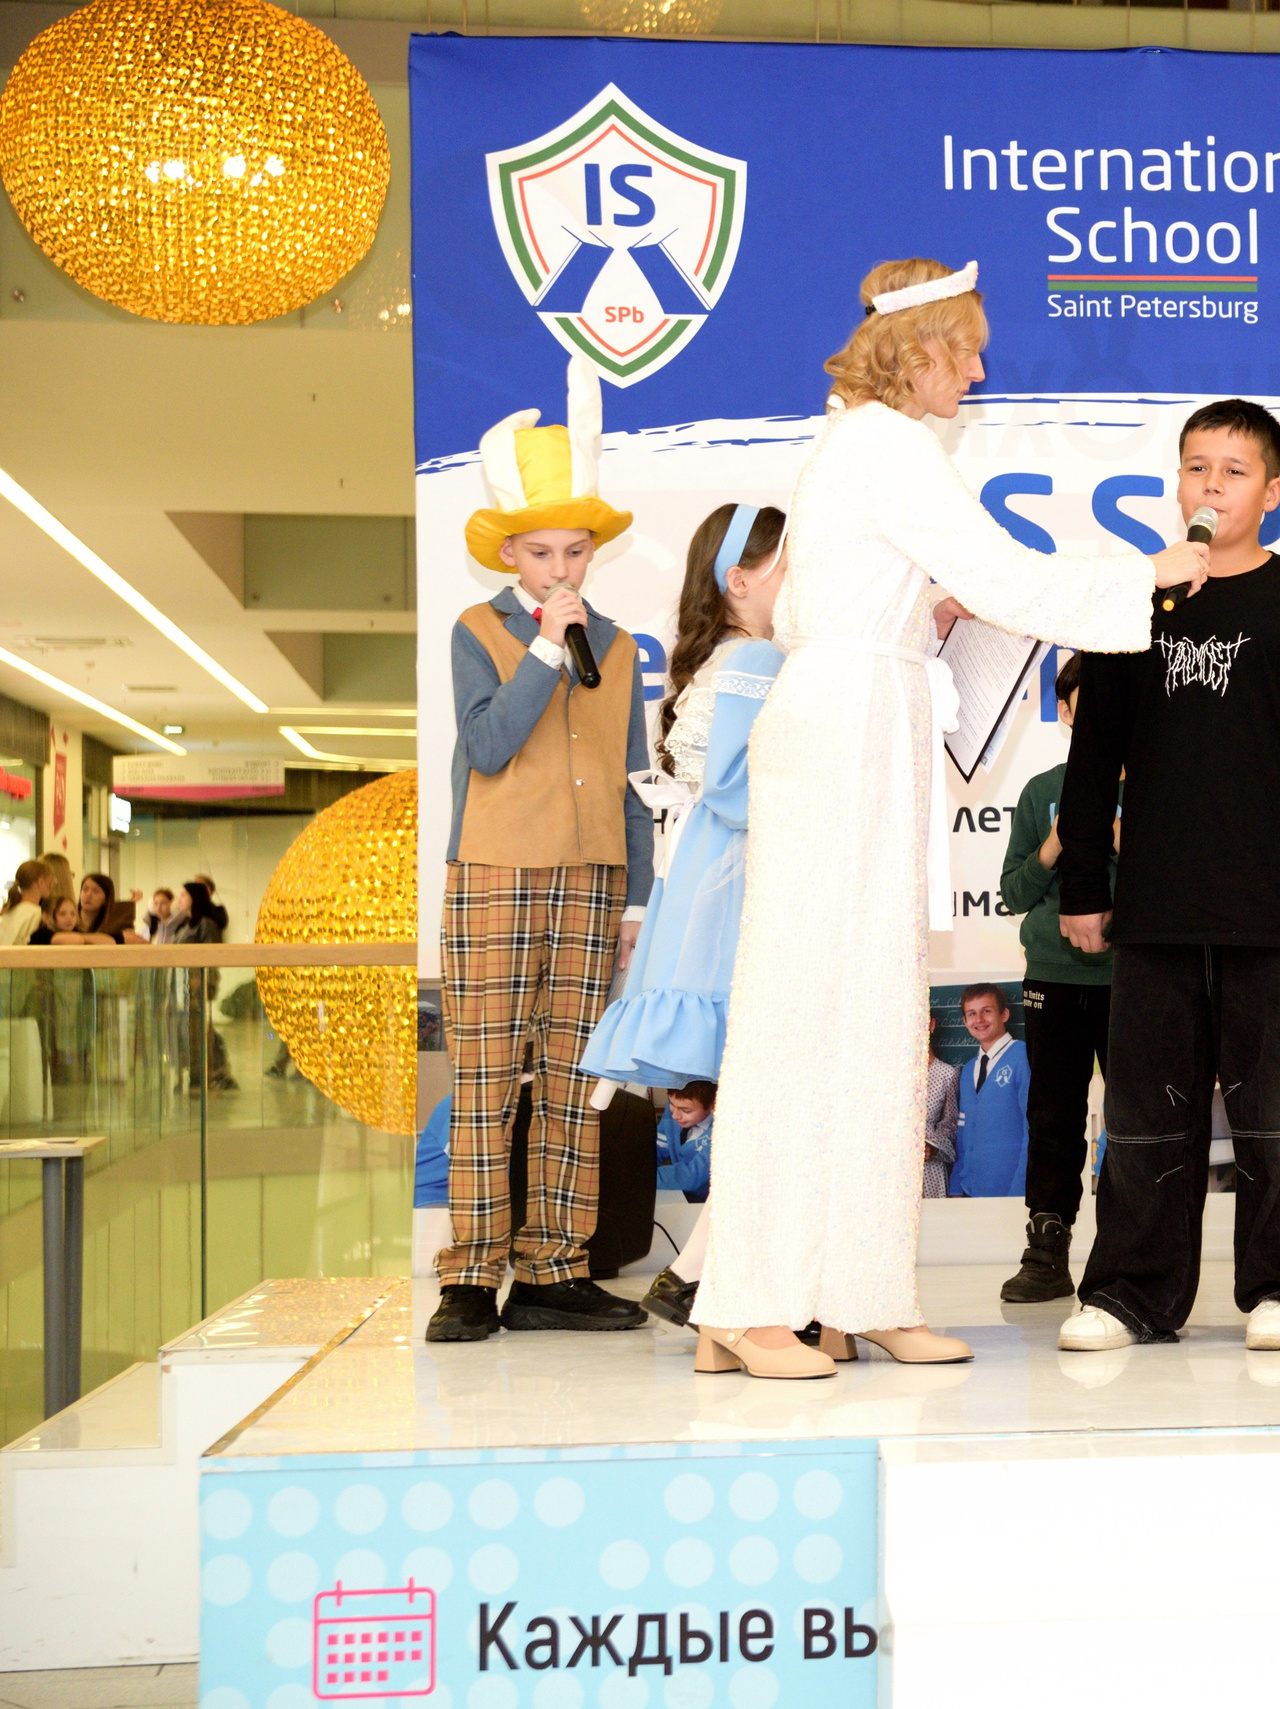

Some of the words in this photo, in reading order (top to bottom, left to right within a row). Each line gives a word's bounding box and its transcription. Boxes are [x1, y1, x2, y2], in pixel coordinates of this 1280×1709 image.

[584, 163, 656, 228] IS
[1046, 206, 1259, 264] School
[604, 305, 645, 324] SPb
[1047, 294, 1113, 318] Saint
[1120, 294, 1260, 325] Petersburg
[479, 1602, 774, 1677] Каждые
